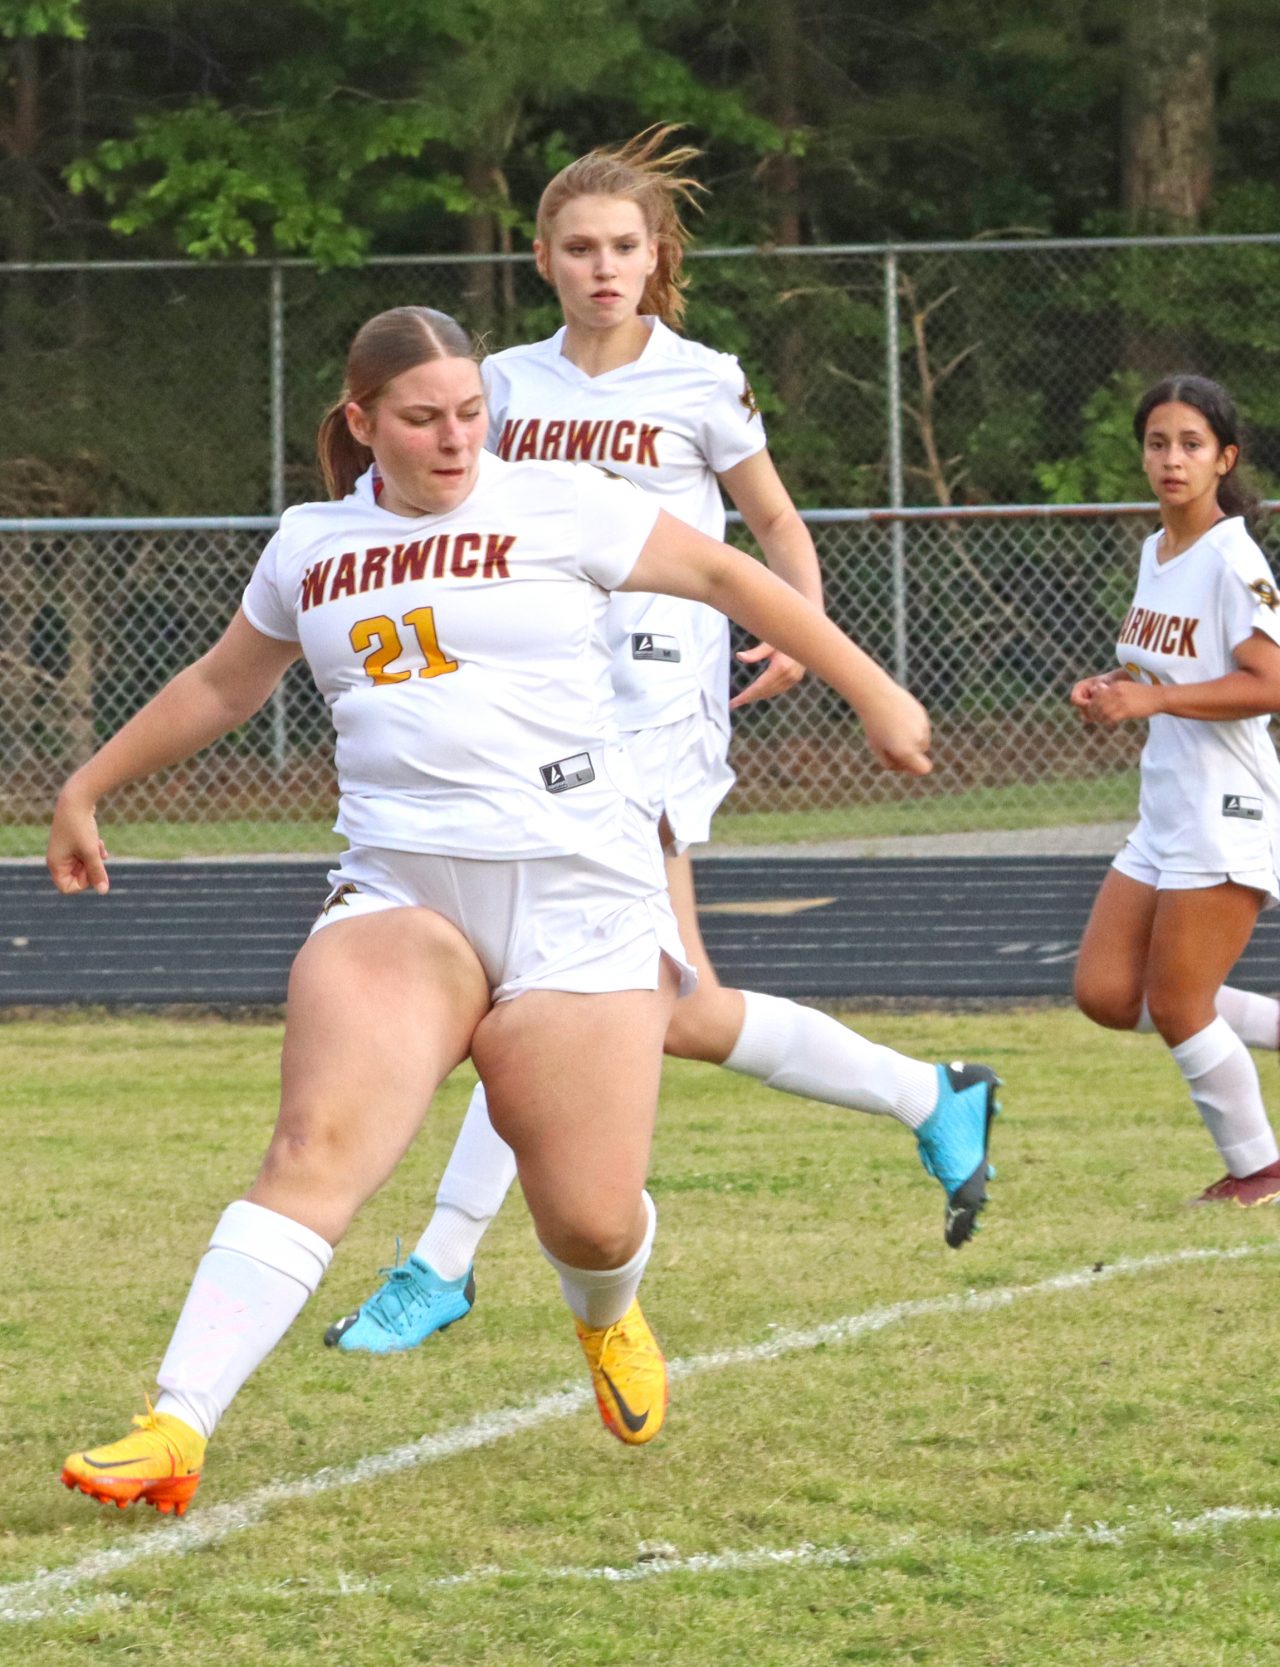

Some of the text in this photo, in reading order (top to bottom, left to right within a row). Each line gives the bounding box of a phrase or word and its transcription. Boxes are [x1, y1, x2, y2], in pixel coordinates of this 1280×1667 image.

[497, 418, 663, 468] WARWICK
[301, 532, 518, 612] WARWICK
[348, 606, 459, 687] 21
